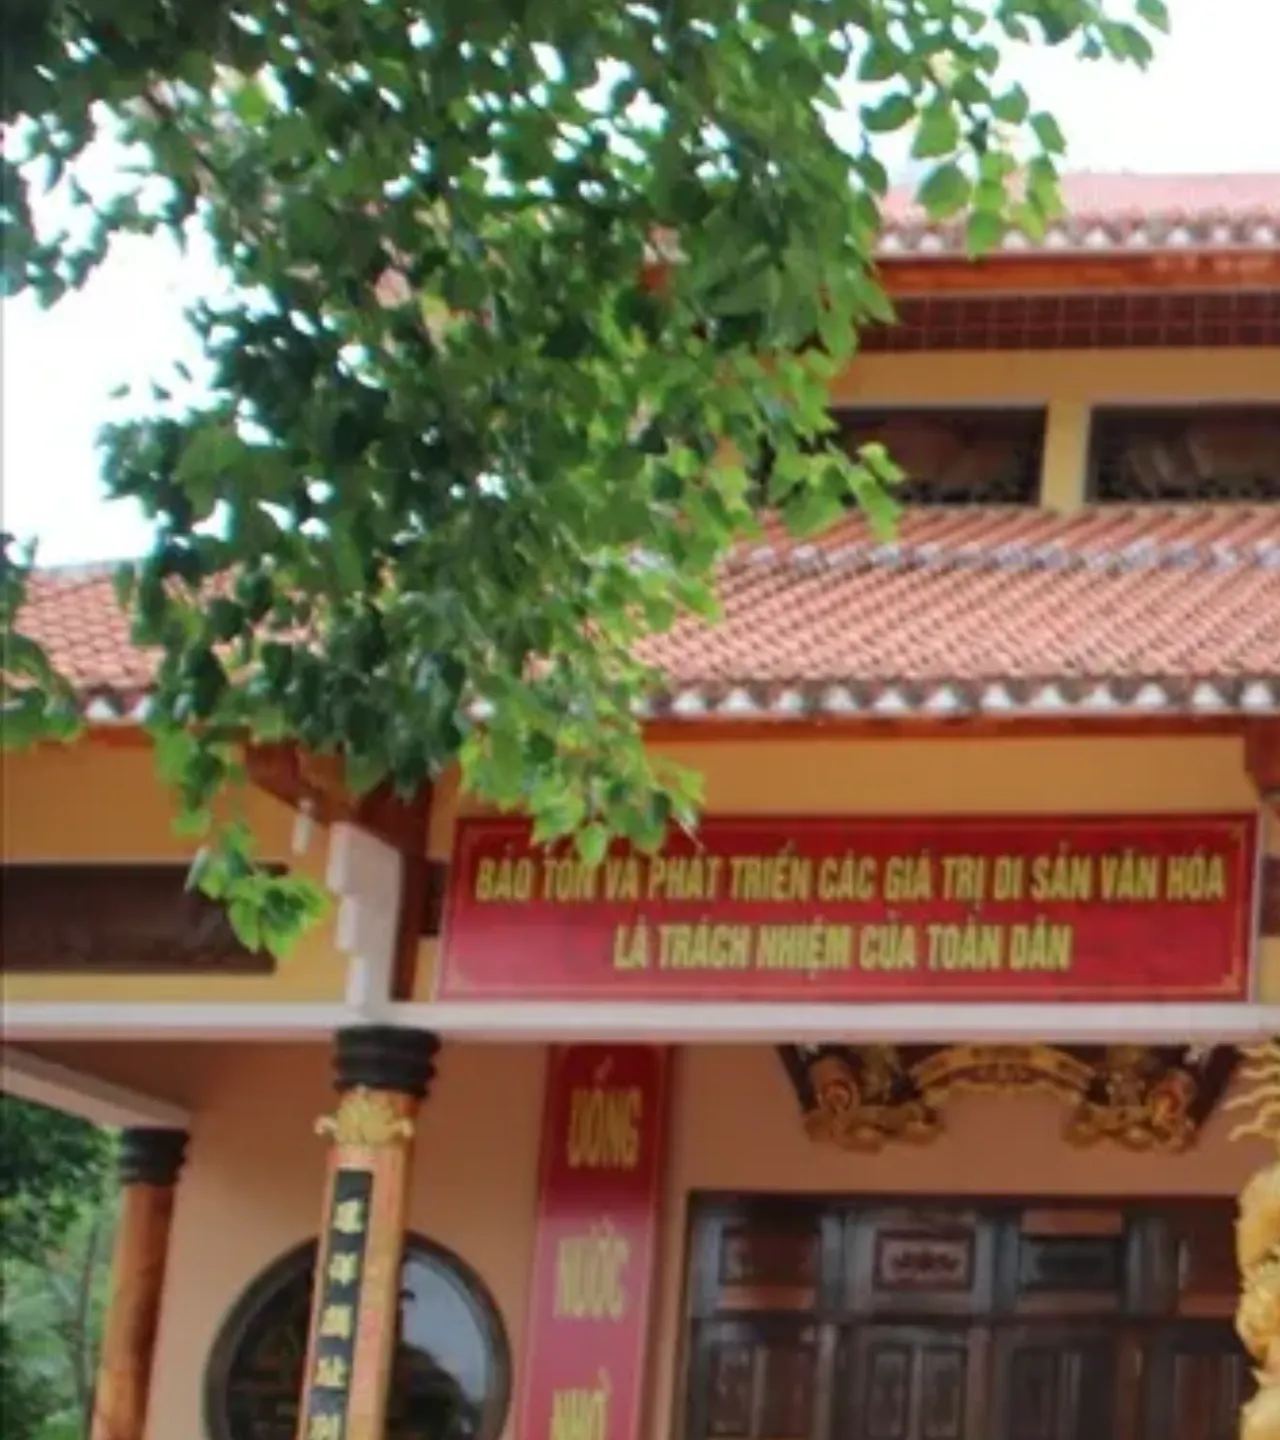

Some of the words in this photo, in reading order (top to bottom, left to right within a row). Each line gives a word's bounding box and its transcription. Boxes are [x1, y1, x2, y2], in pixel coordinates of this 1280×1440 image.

[477, 846, 534, 901] BẢO
[649, 847, 721, 901] PHÁT
[730, 840, 813, 901] TRIỂN
[819, 850, 876, 900] CÁC
[884, 850, 932, 900] GIÁ
[942, 855, 984, 911] TRỊ
[994, 857, 1023, 900] DI
[1030, 842, 1091, 901] SẢN
[1100, 850, 1157, 901] VĂN
[659, 915, 749, 969] TRÁCH
[756, 916, 850, 979] NHIỆM
[859, 911, 915, 970] CỦA
[1009, 916, 1073, 970] DÂN
[568, 1056, 641, 1169] UỐNG
